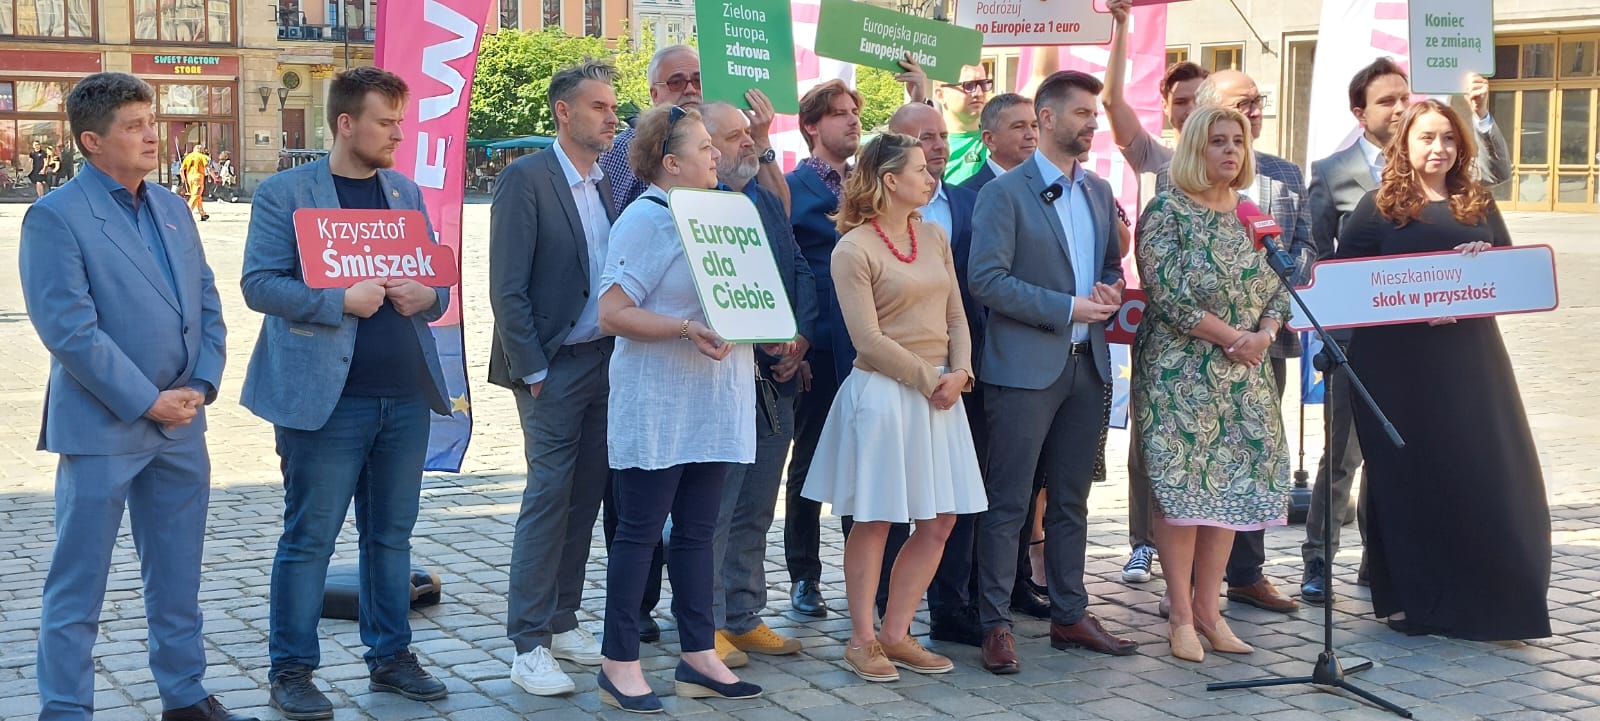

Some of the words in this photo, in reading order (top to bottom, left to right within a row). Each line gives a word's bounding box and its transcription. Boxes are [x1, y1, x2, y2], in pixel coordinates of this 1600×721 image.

[723, 3, 766, 22] Zielona
[1424, 12, 1465, 28] Koniec
[724, 22, 768, 44] Europa,
[863, 17, 911, 42] Europejska
[913, 30, 937, 47] praca
[991, 18, 1031, 36] Europie
[1033, 22, 1045, 33] za
[1048, 21, 1054, 32] 1
[1056, 20, 1080, 32] euro
[726, 42, 770, 61] zdrowa
[1425, 36, 1439, 48] ze
[1441, 32, 1482, 53] zmianą
[154, 56, 182, 64] SWEET
[183, 56, 220, 65] FACTORY
[174, 66, 203, 74] STORE
[727, 60, 769, 82] Europa
[1426, 56, 1459, 68] czasu
[317, 216, 406, 245] Krzysztof
[688, 218, 762, 254] Europa
[322, 240, 436, 278] Śmiszek
[702, 250, 737, 277] dla
[1371, 266, 1462, 287] Mieszkaniowy
[712, 281, 776, 310] Ciebie
[1372, 291, 1406, 307] skok
[1409, 293, 1420, 304] w
[1423, 282, 1497, 307] przyszłość
